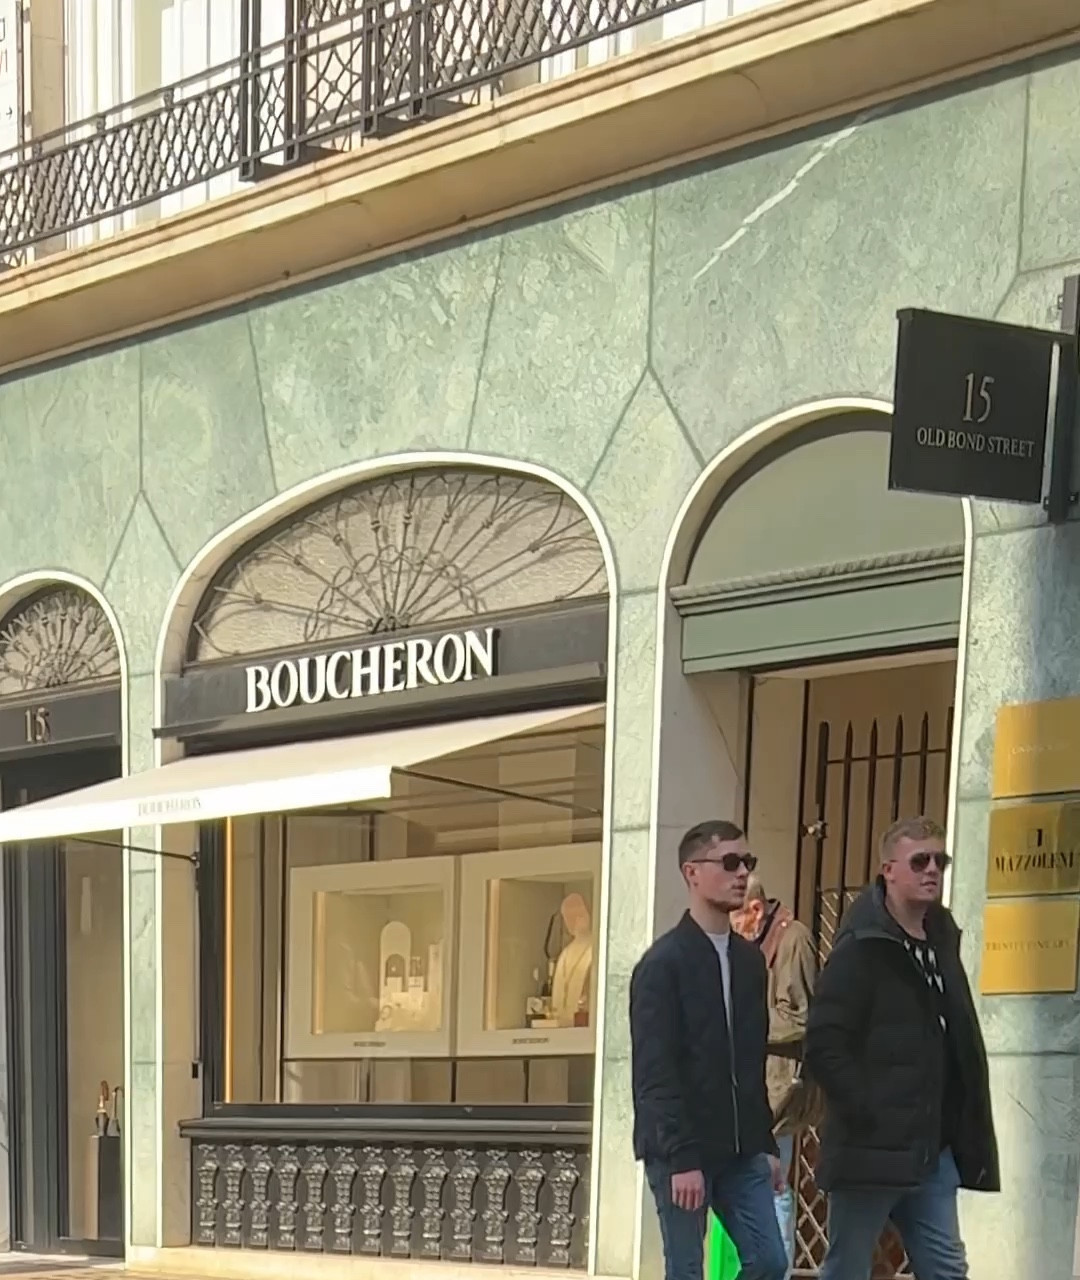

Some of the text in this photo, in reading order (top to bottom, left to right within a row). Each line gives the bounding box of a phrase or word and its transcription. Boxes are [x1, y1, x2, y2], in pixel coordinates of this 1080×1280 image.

[963, 372, 995, 423] 15
[916, 426, 1035, 458] OLD BOND STREET
[245, 627, 495, 713] BOUCHERON
[24, 706, 47, 743] 15
